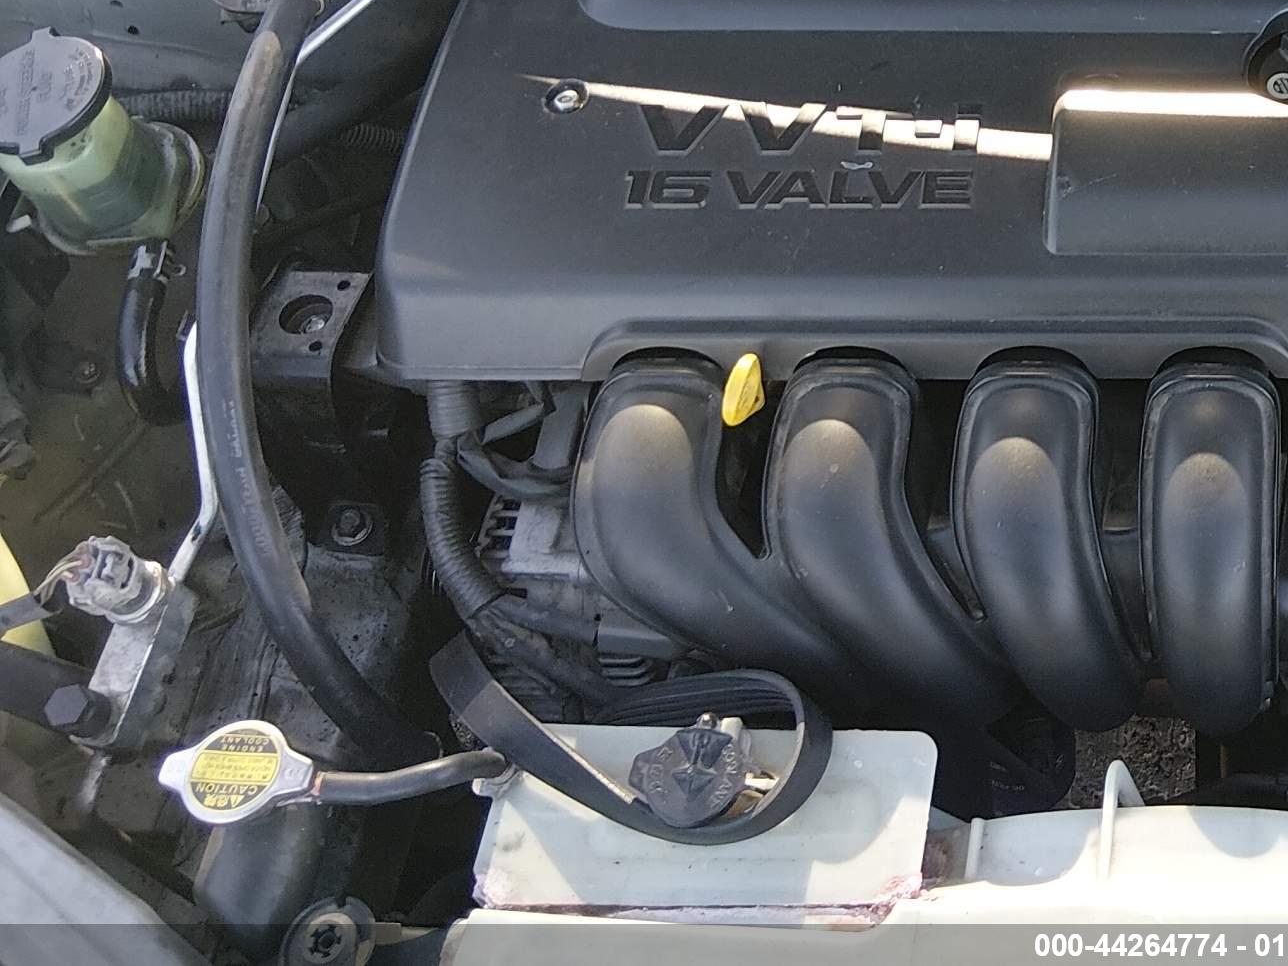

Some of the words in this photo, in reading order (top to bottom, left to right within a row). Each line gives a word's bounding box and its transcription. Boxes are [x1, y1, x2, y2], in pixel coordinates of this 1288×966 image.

[624, 169, 712, 210] 16
[726, 169, 975, 210] VALVE
[221, 736, 270, 745] COOLANT
[221, 743, 264, 753] ENGINE
[195, 782, 259, 795] CAUTION
